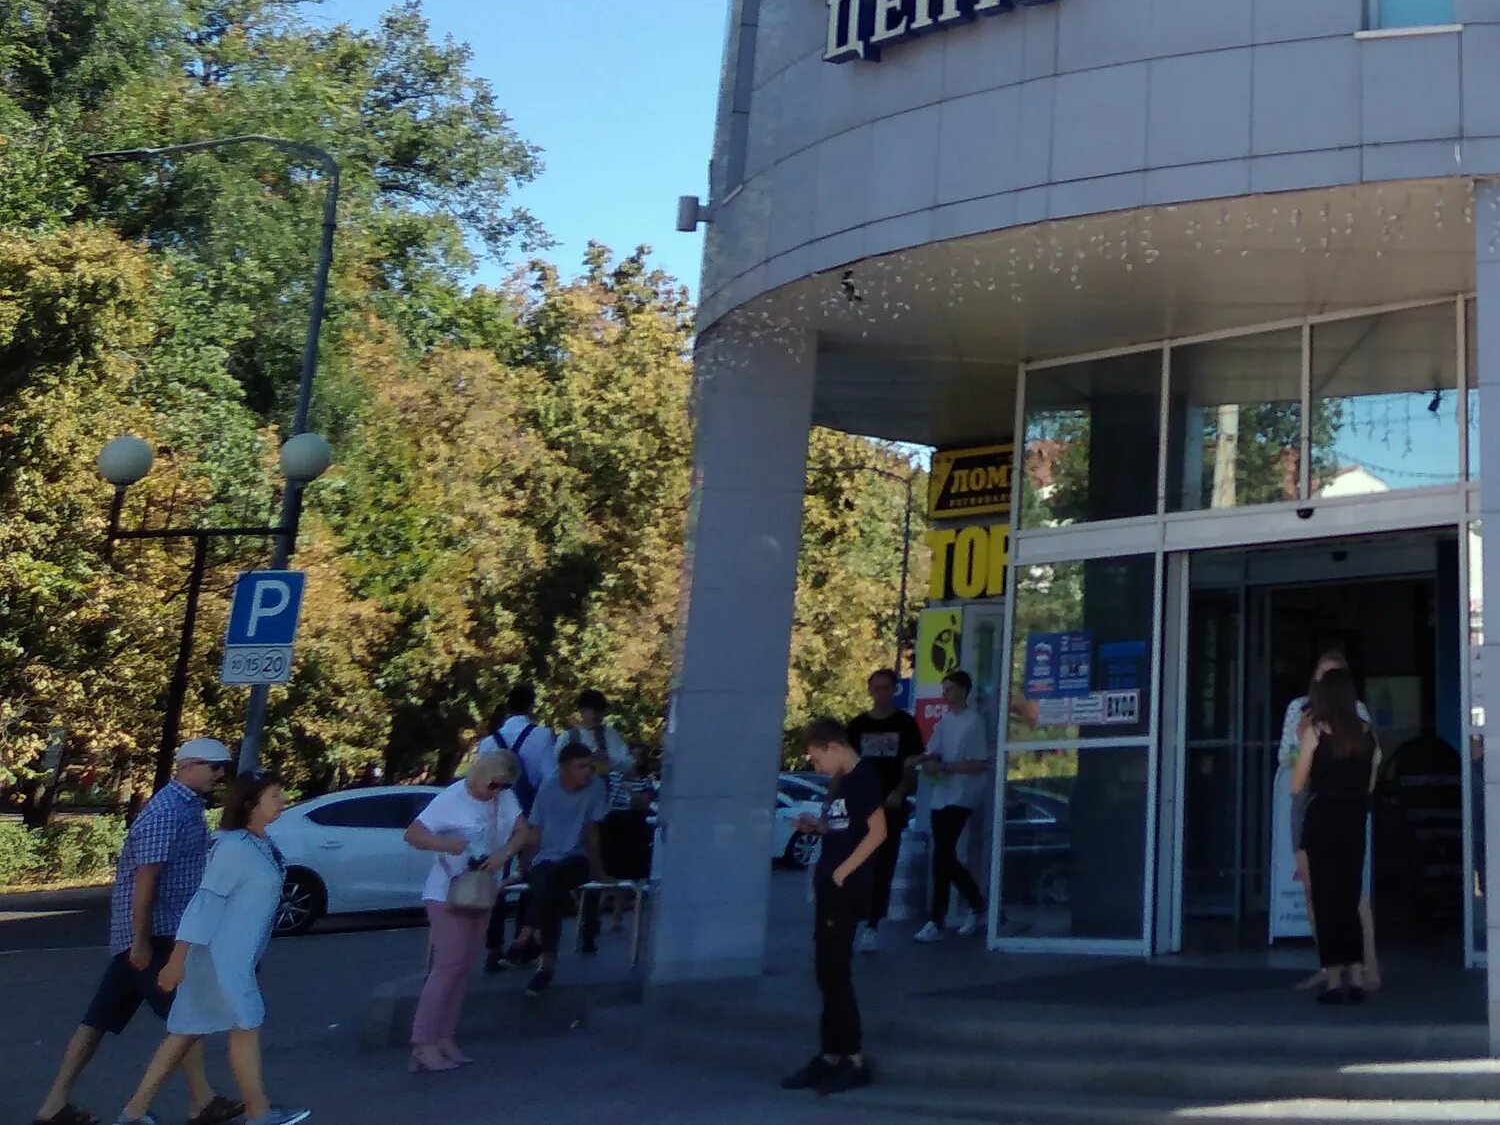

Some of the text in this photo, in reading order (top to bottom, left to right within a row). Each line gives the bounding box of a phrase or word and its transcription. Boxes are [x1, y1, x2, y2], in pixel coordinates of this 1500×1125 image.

[950, 463, 1011, 493] ЛОМ
[246, 579, 291, 637] P
[262, 656, 283, 673] 20
